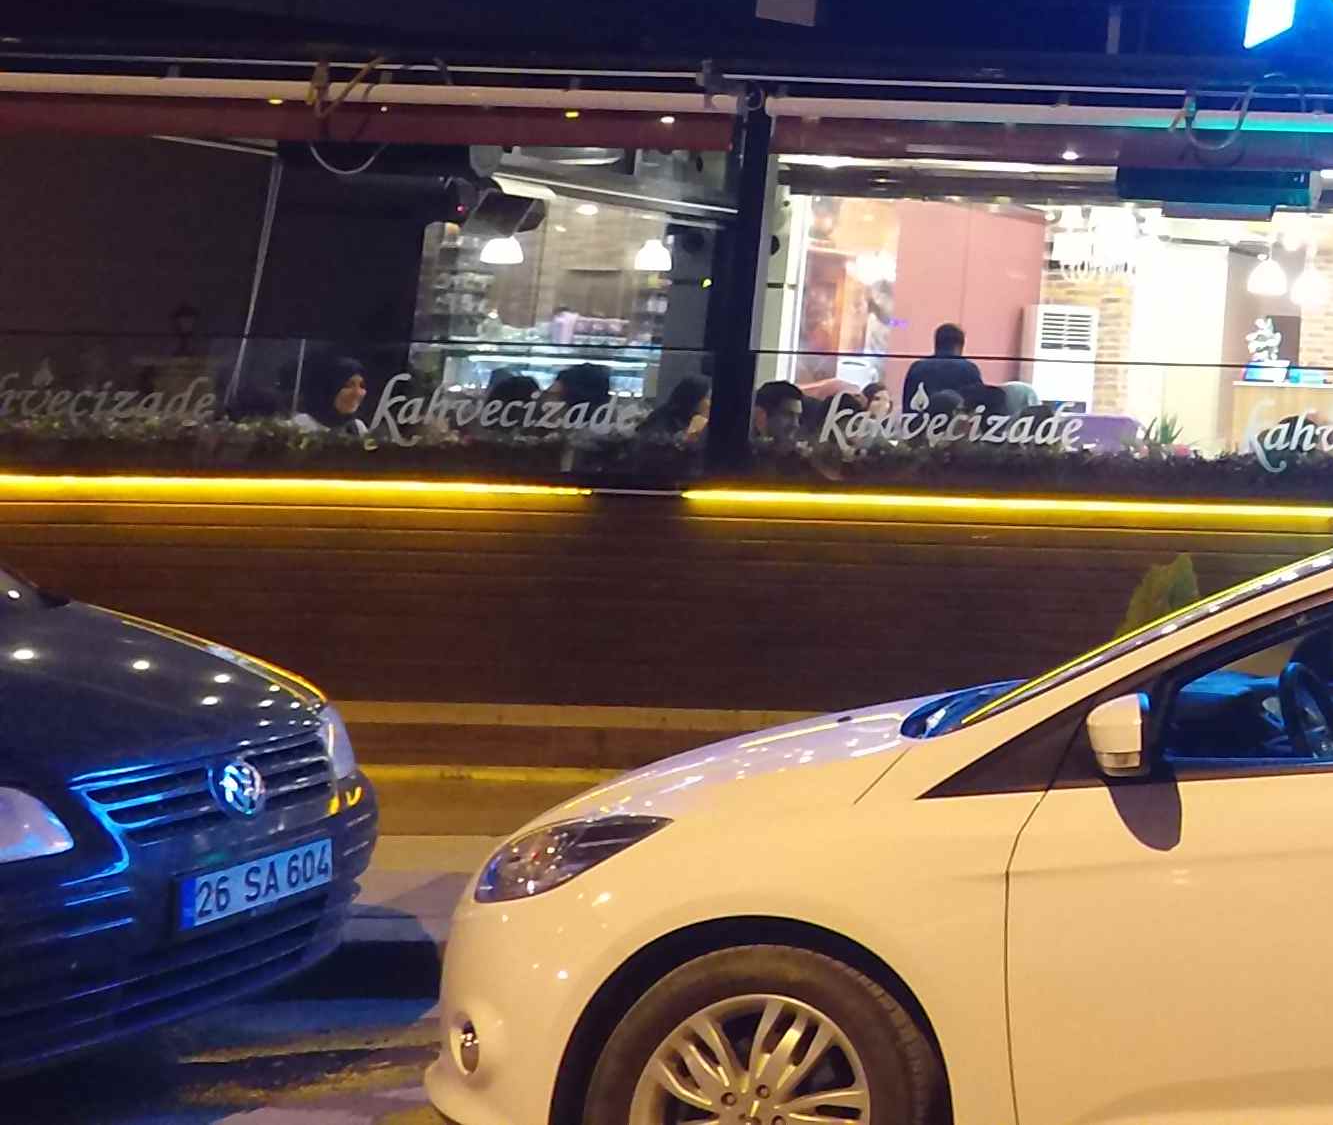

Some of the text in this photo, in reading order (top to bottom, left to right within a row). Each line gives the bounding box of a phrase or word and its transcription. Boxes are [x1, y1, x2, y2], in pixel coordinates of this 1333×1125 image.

[370, 372, 640, 446] kahvecizade
[819, 385, 1085, 458] kahvecizade
[197, 844, 330, 918] 26 SA 604
